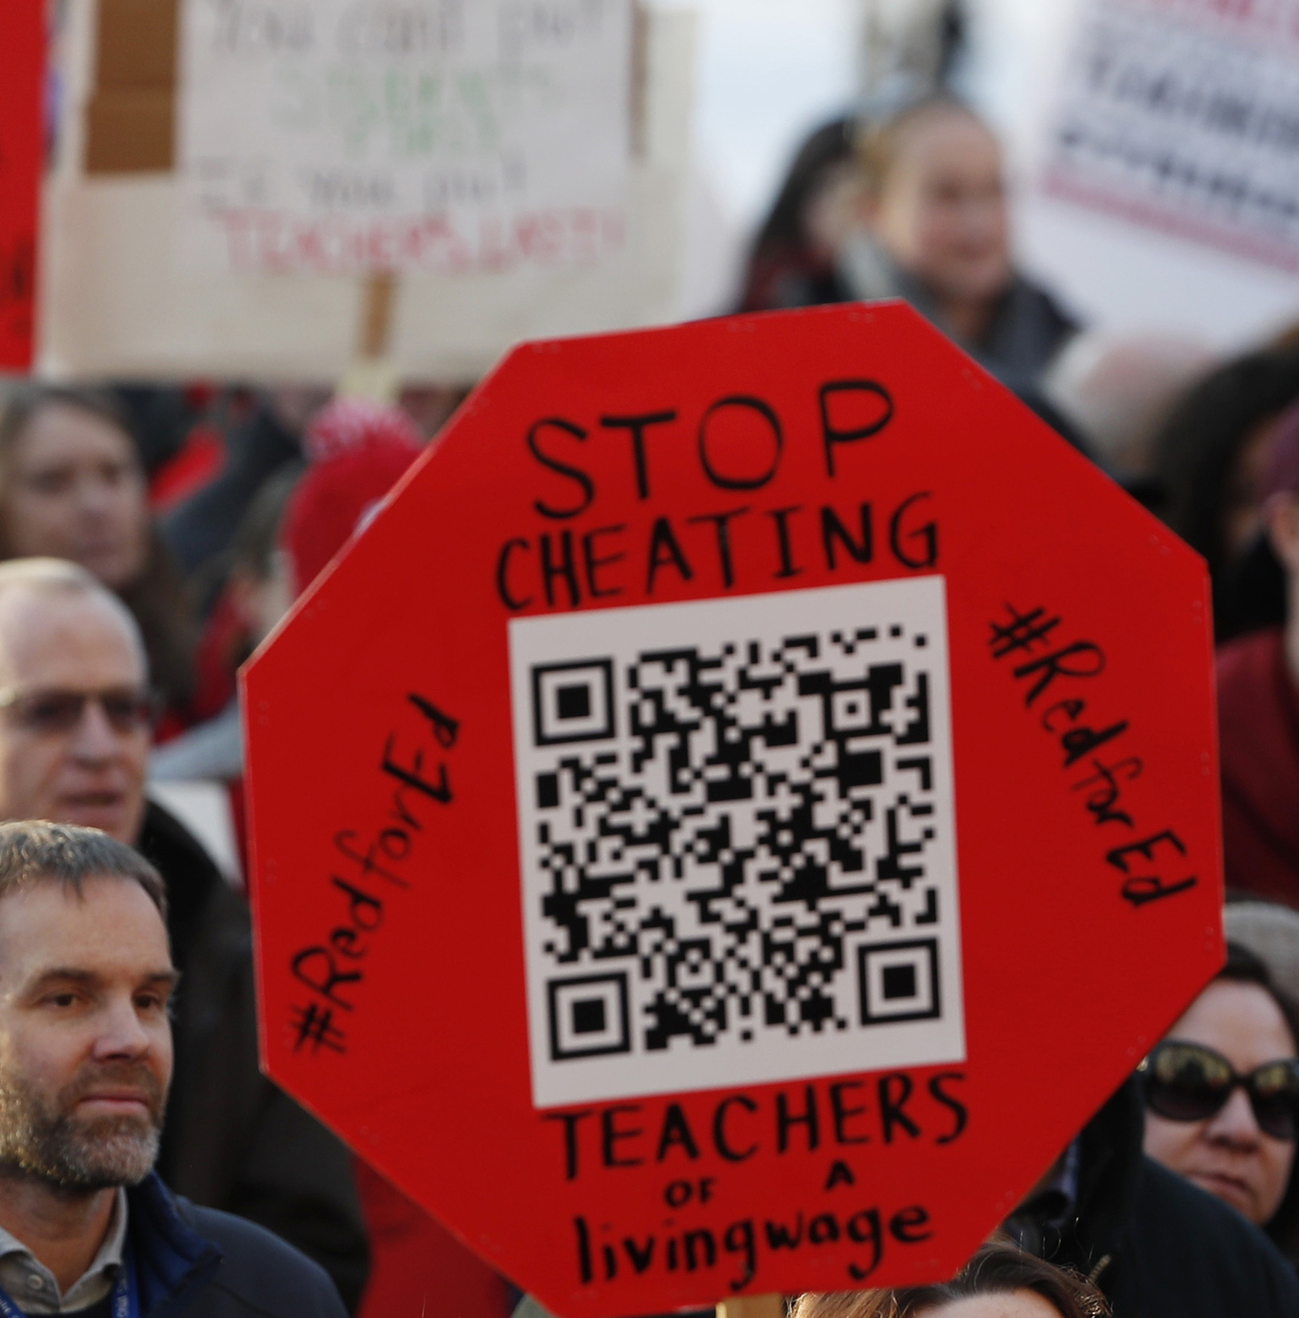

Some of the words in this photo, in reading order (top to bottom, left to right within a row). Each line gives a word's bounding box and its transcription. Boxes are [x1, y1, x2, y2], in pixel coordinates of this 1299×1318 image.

[524, 379, 895, 521] STOP
[495, 491, 940, 613] CHEATING
[986, 602, 1198, 911] #RedforEd
[290, 691, 462, 1057] #RedforEd
[543, 1071, 970, 1181] TEACHERS
[663, 1175, 718, 1209] OF
[824, 1160, 856, 1193] A
